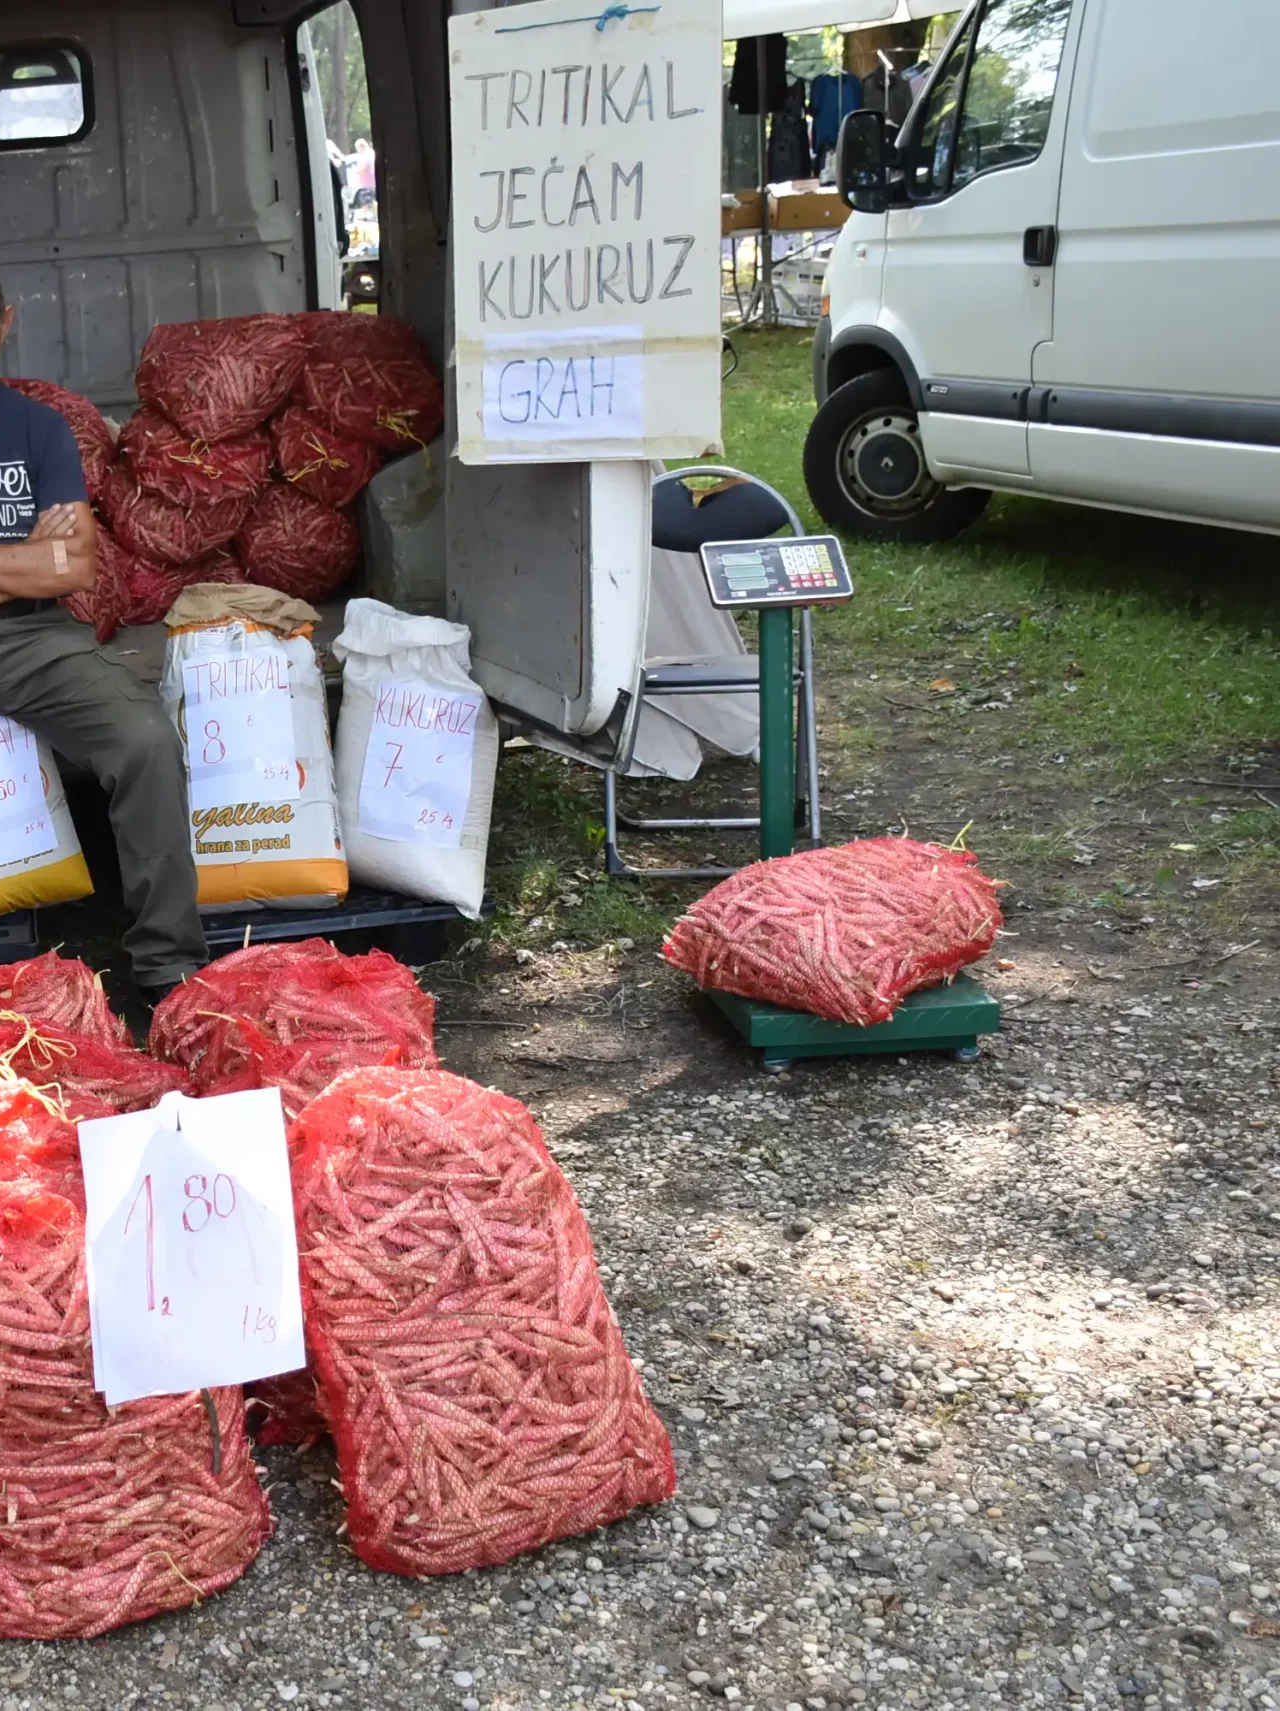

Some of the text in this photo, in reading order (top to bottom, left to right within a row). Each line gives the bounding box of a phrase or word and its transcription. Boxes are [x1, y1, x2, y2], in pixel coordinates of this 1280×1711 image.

[465, 62, 704, 131] TRITIKAL
[479, 234, 695, 323] KUKURUZ
[498, 354, 616, 424] GRAH
[187, 655, 288, 702] TRITIKAL
[376, 687, 476, 735] KUKURUZ
[203, 719, 226, 765] 8
[384, 742, 403, 787] 7
[263, 766, 275, 781] 25
[25, 823, 35, 836] 25
[418, 808, 439, 825] 25
[196, 833, 291, 854] hrana za perad
